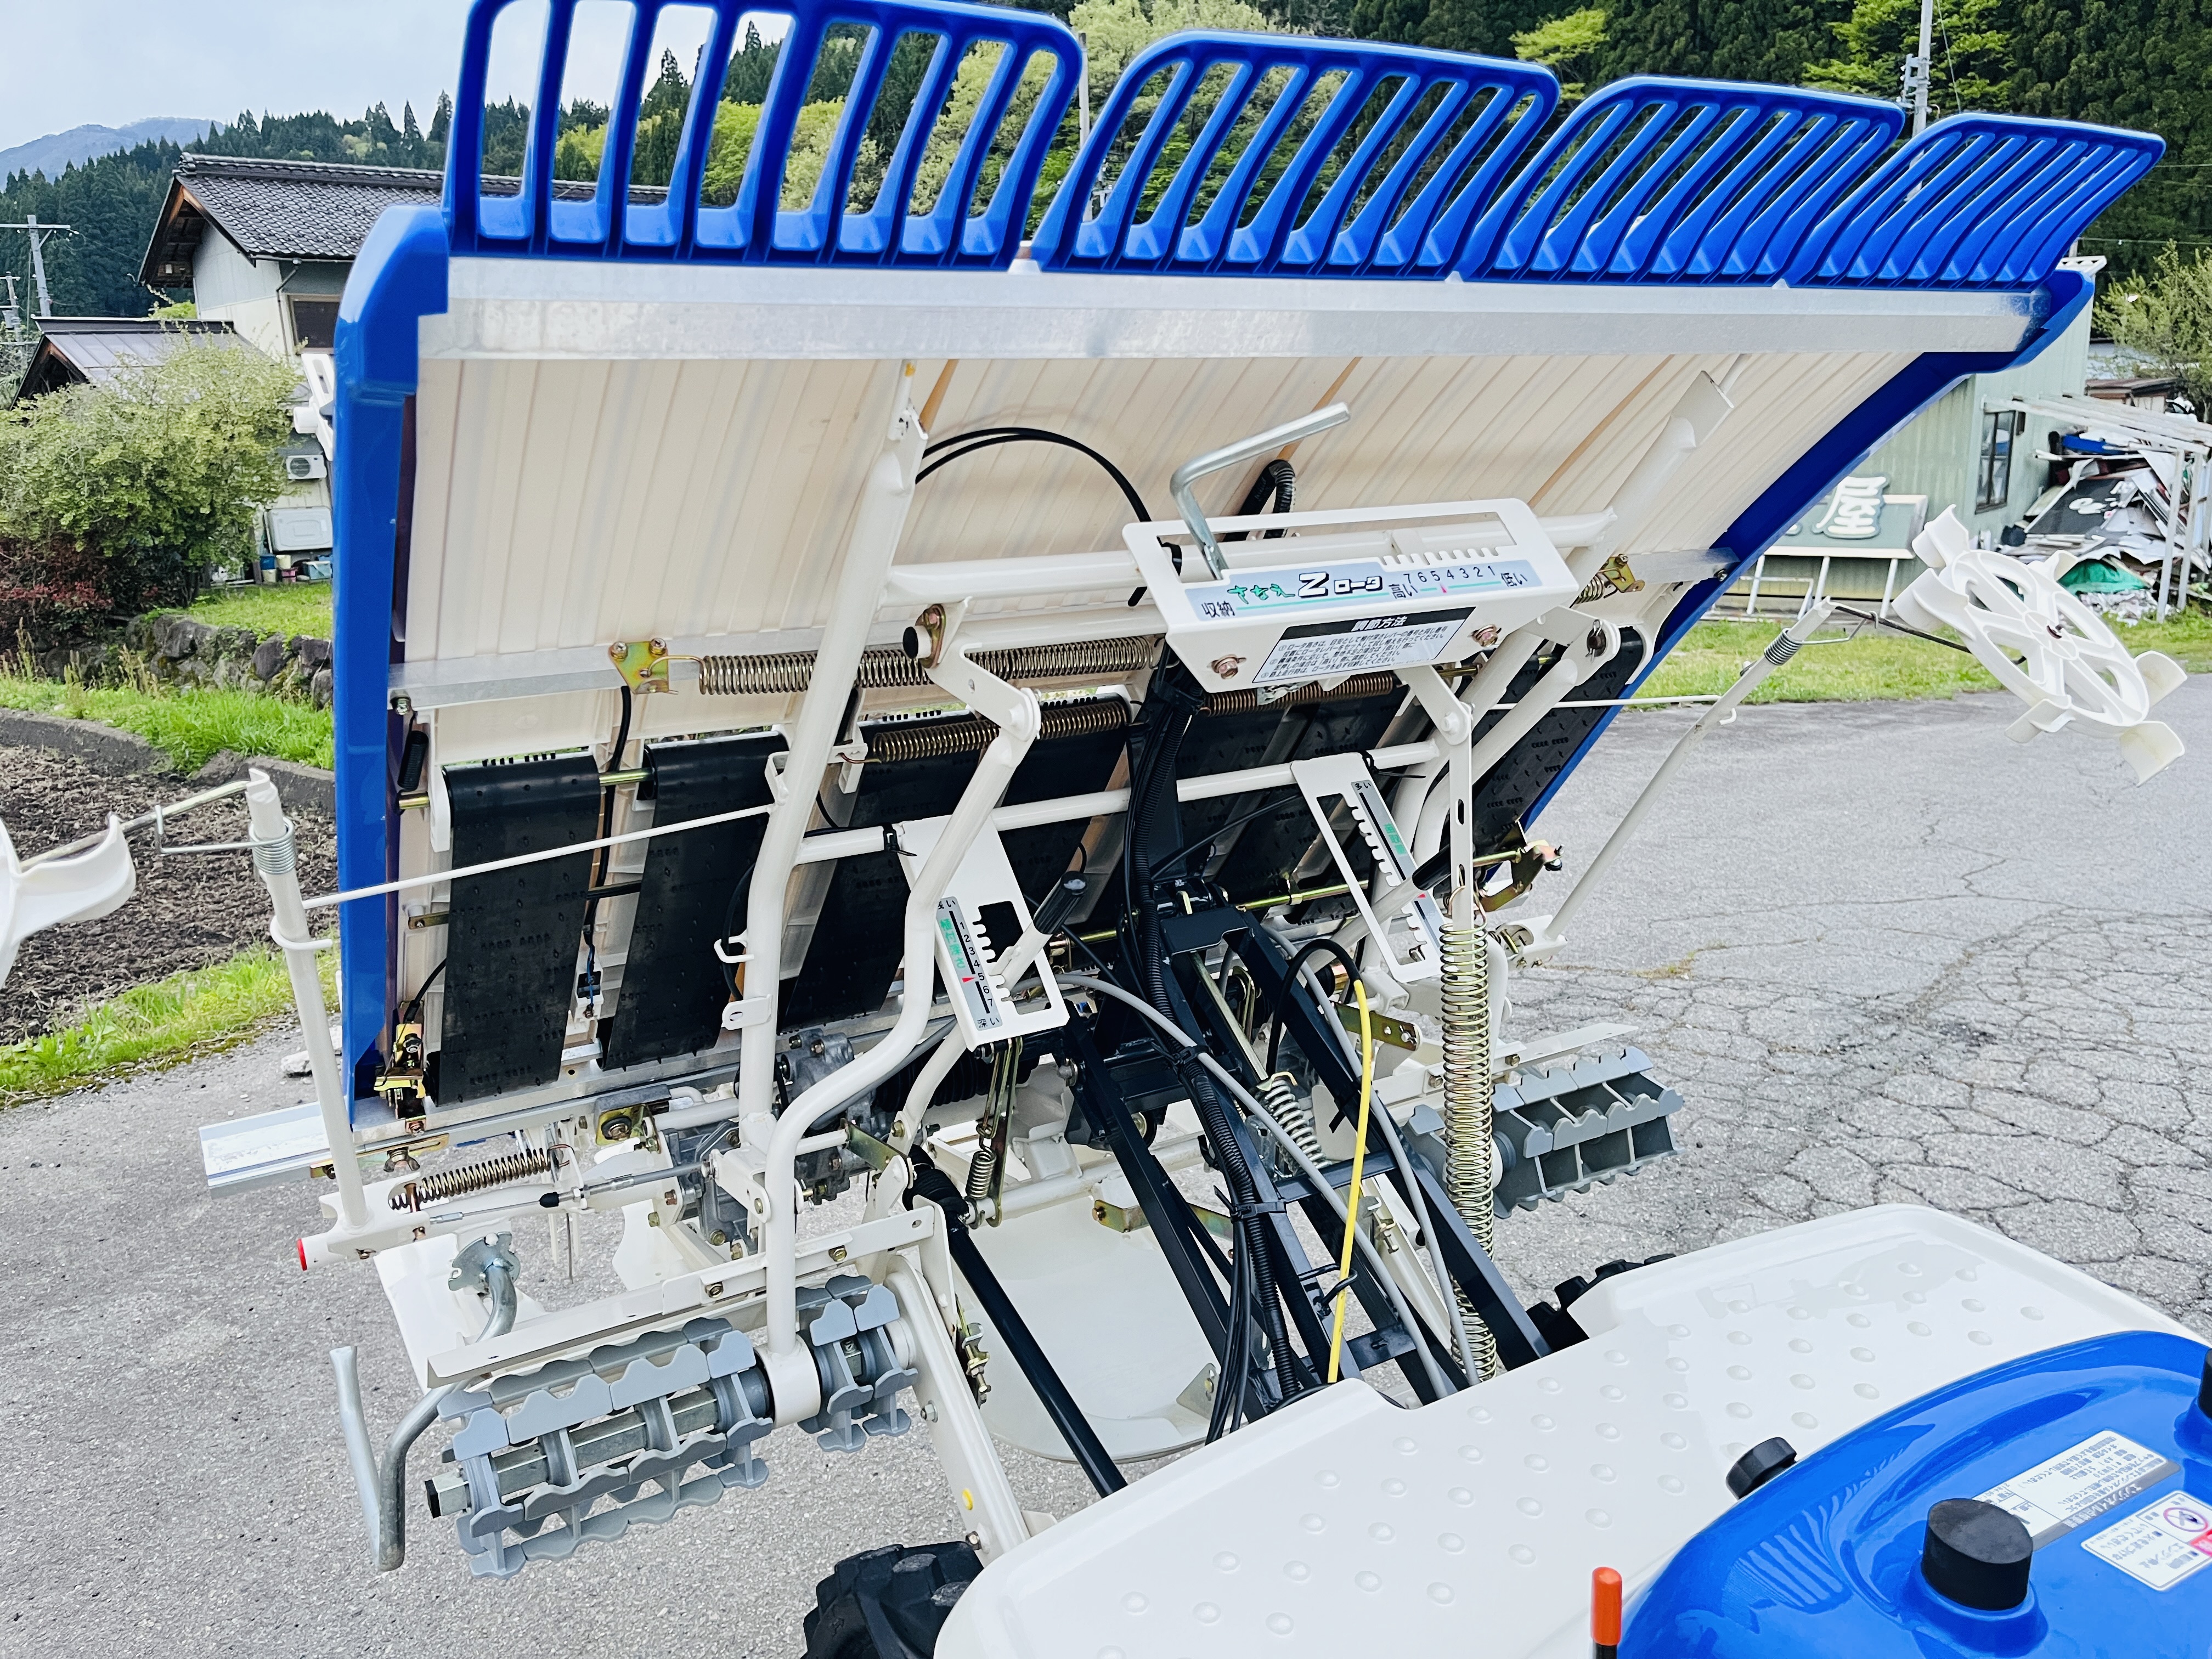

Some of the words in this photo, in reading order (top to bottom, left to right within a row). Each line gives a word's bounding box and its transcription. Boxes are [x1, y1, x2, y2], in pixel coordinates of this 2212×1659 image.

[1787, 476, 1887, 535] 屋
[1430, 571, 1441, 581] 5
[1446, 569, 1454, 579] 4
[1459, 568, 1469, 578] 3
[1473, 567, 1483, 577] 2
[1487, 566, 1496, 576] 1
[1403, 573, 1411, 584] 7
[1418, 572, 1427, 582] 6
[1500, 572, 1528, 587] 低い
[1227, 583, 1296, 605] さなえ
[1298, 571, 1329, 599] Z
[1334, 576, 1383, 595] ロータ
[1389, 583, 1418, 599] 高い
[1201, 601, 1235, 618] 収納
[1351, 616, 1408, 632] 調節方法
[1355, 782, 1372, 791] 多い
[983, 985, 990, 994] 6
[977, 1018, 999, 1028] 深い
